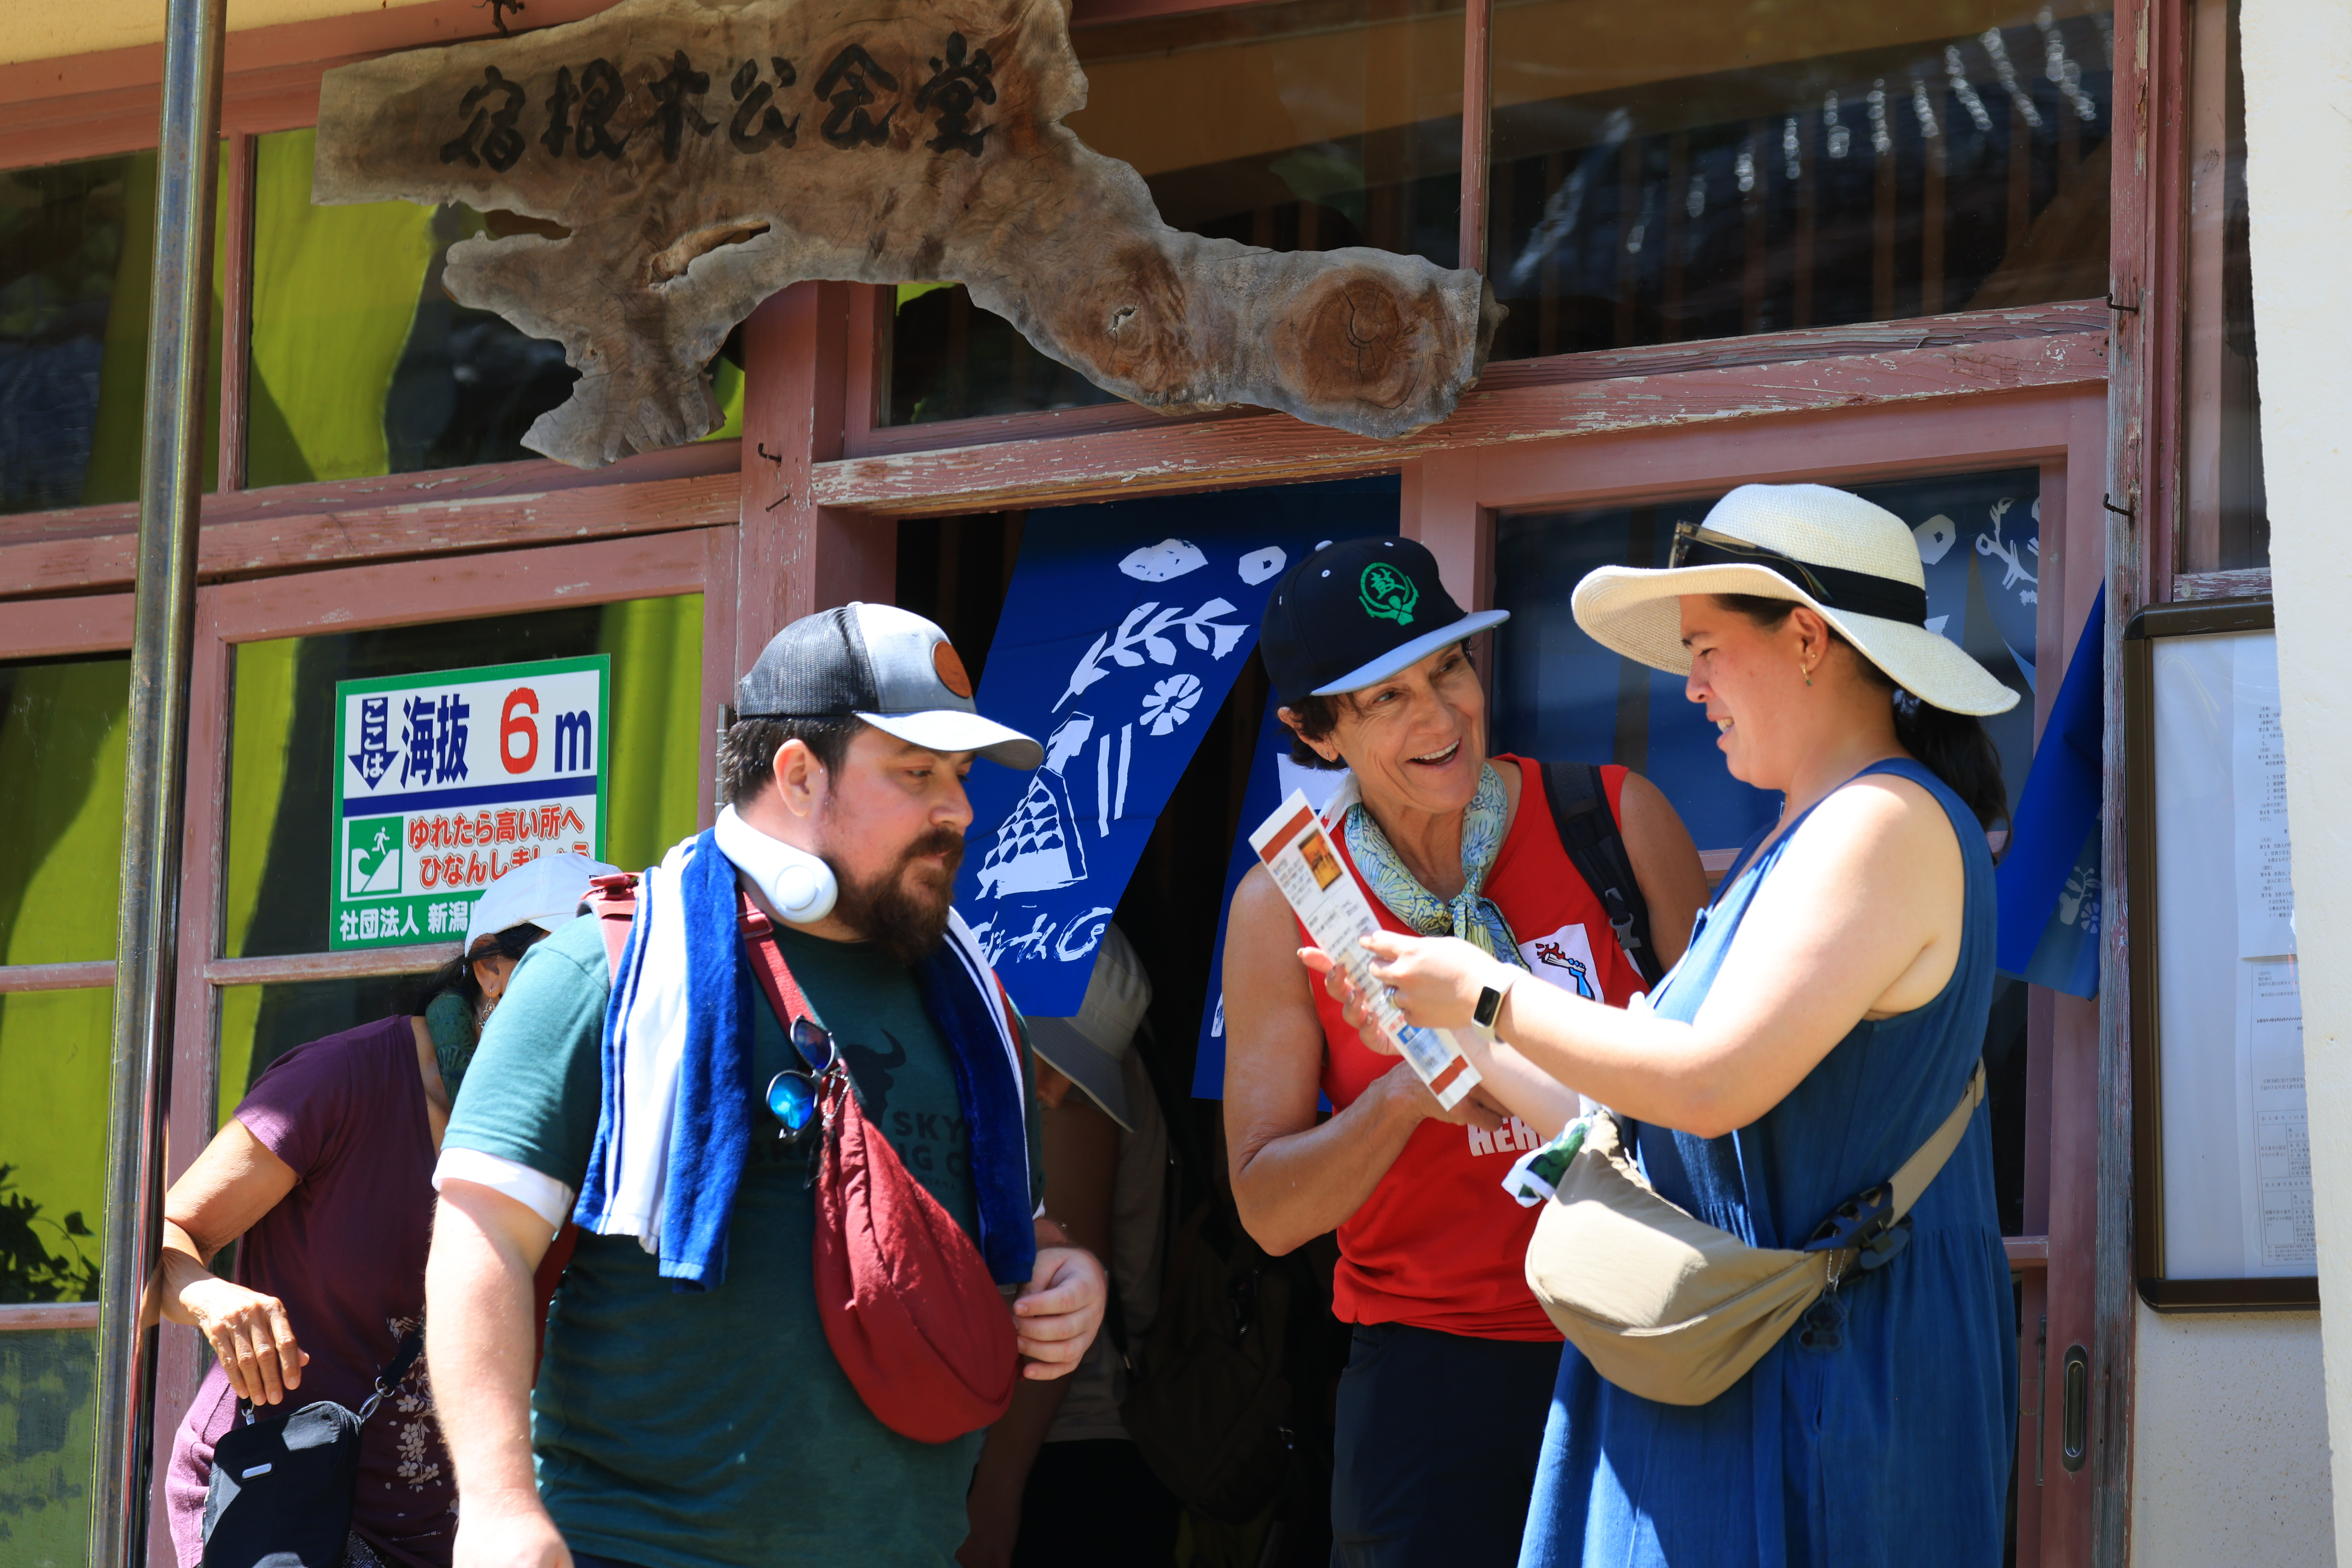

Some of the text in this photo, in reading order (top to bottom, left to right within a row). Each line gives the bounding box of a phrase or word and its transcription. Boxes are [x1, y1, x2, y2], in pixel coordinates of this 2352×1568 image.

[439, 30, 996, 173] 宿根木公会堂
[362, 699, 385, 779] ここは
[400, 687, 592, 789] 海抜 6 m
[408, 803, 585, 852] ゆれたら高い所へ
[340, 904, 420, 942] 社団法人
